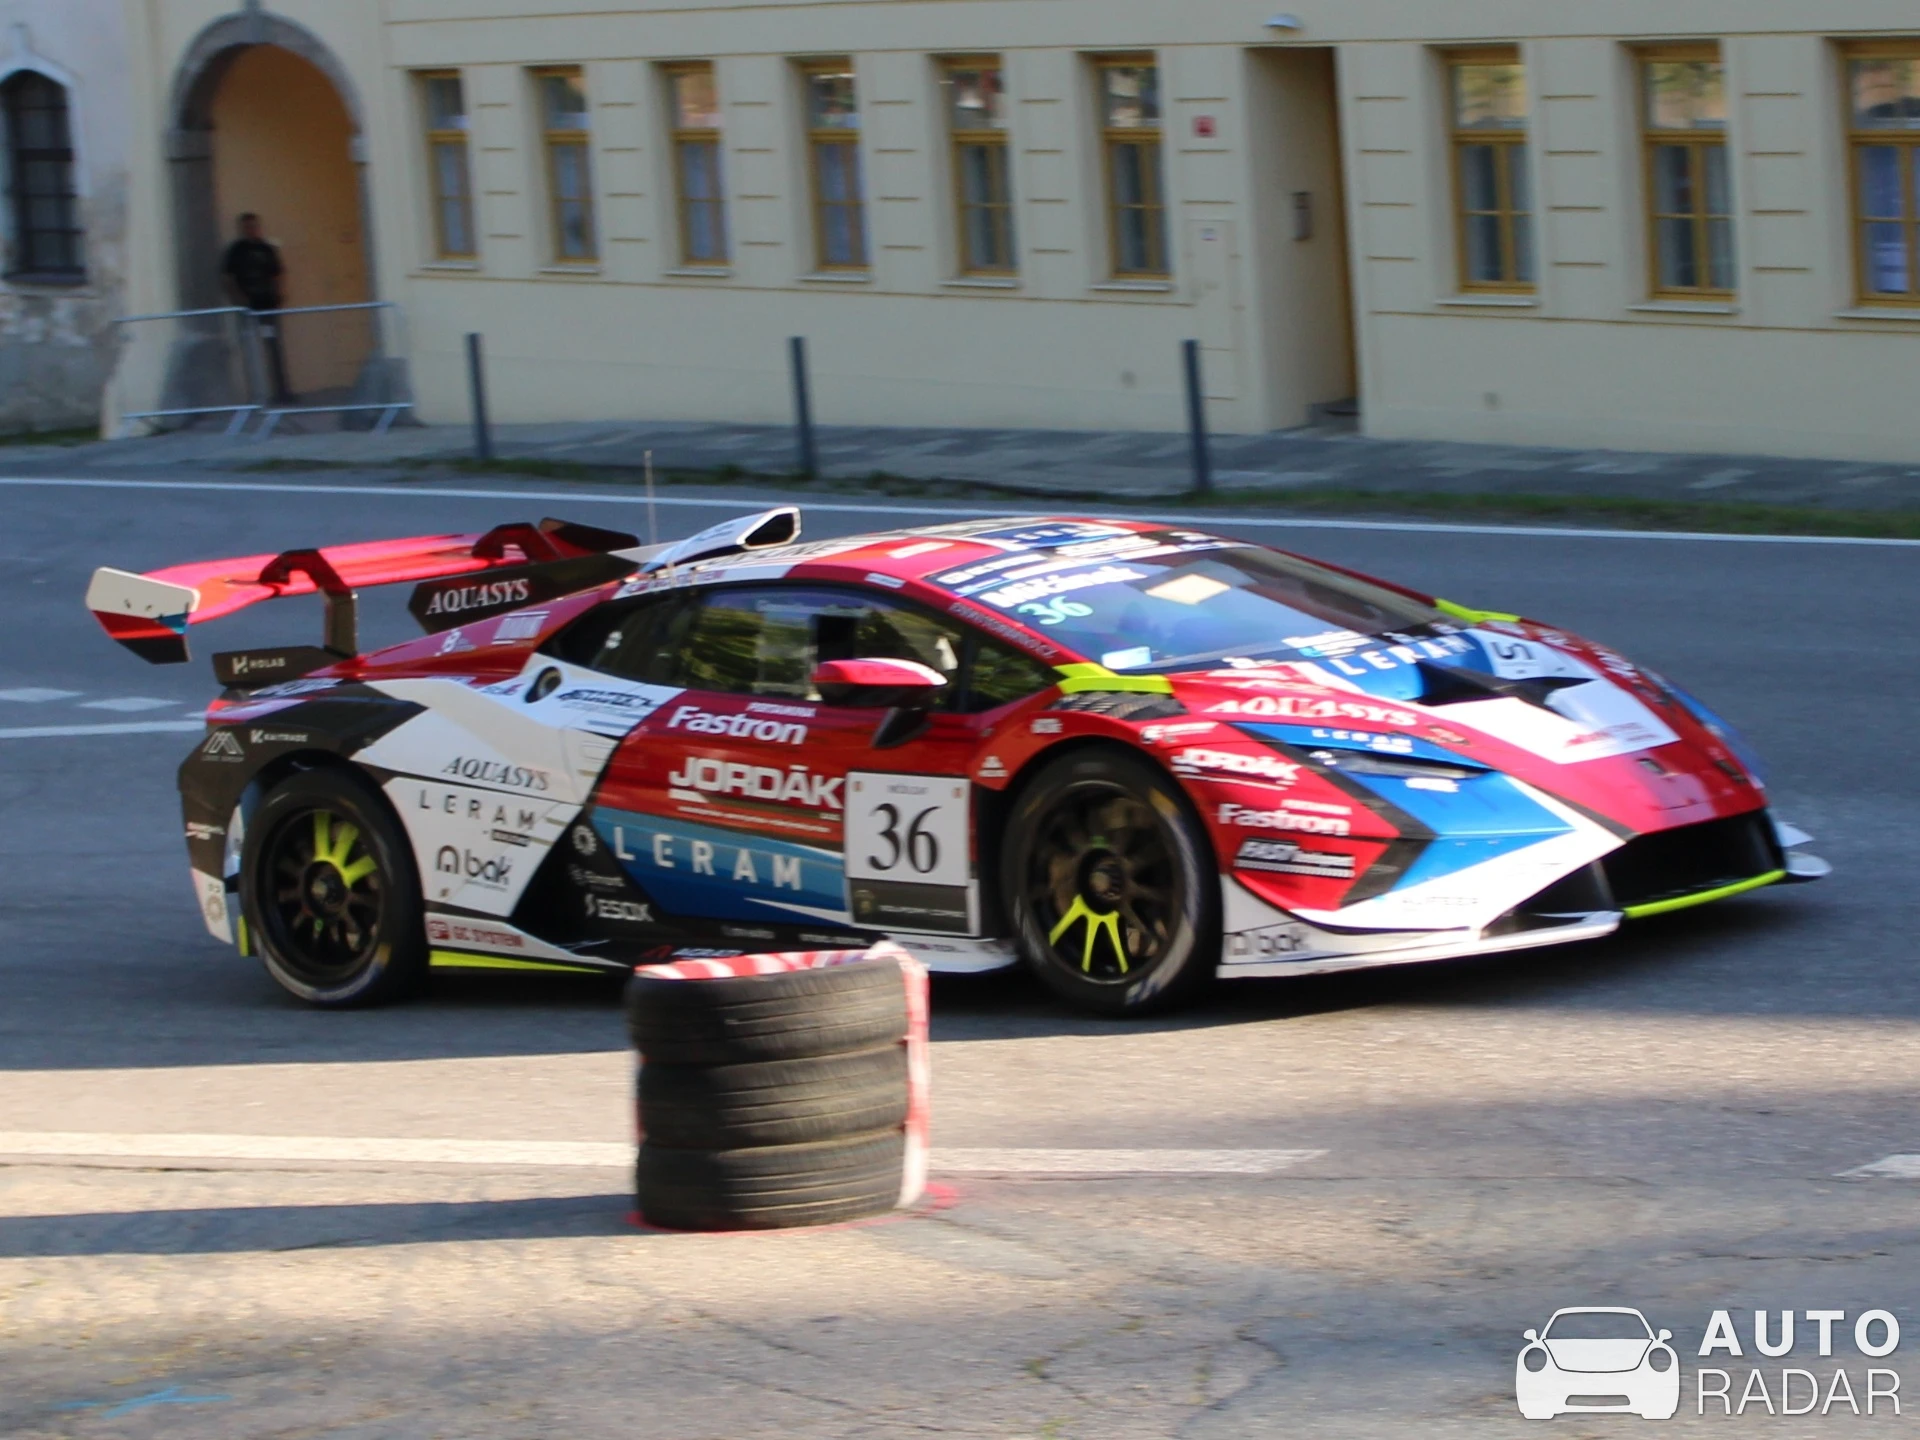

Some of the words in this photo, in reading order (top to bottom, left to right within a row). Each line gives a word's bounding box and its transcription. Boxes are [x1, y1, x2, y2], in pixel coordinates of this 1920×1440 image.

[426, 578, 530, 615] AQUASYS
[1019, 595, 1094, 624] 36
[667, 706, 809, 744] Fastron
[1201, 697, 1418, 726] AQUASYS
[441, 756, 549, 791] AQUASYS
[419, 789, 537, 830] LERAM
[1218, 803, 1351, 836] Fastron
[868, 803, 941, 873] 36
[613, 826, 802, 890] LERAM
